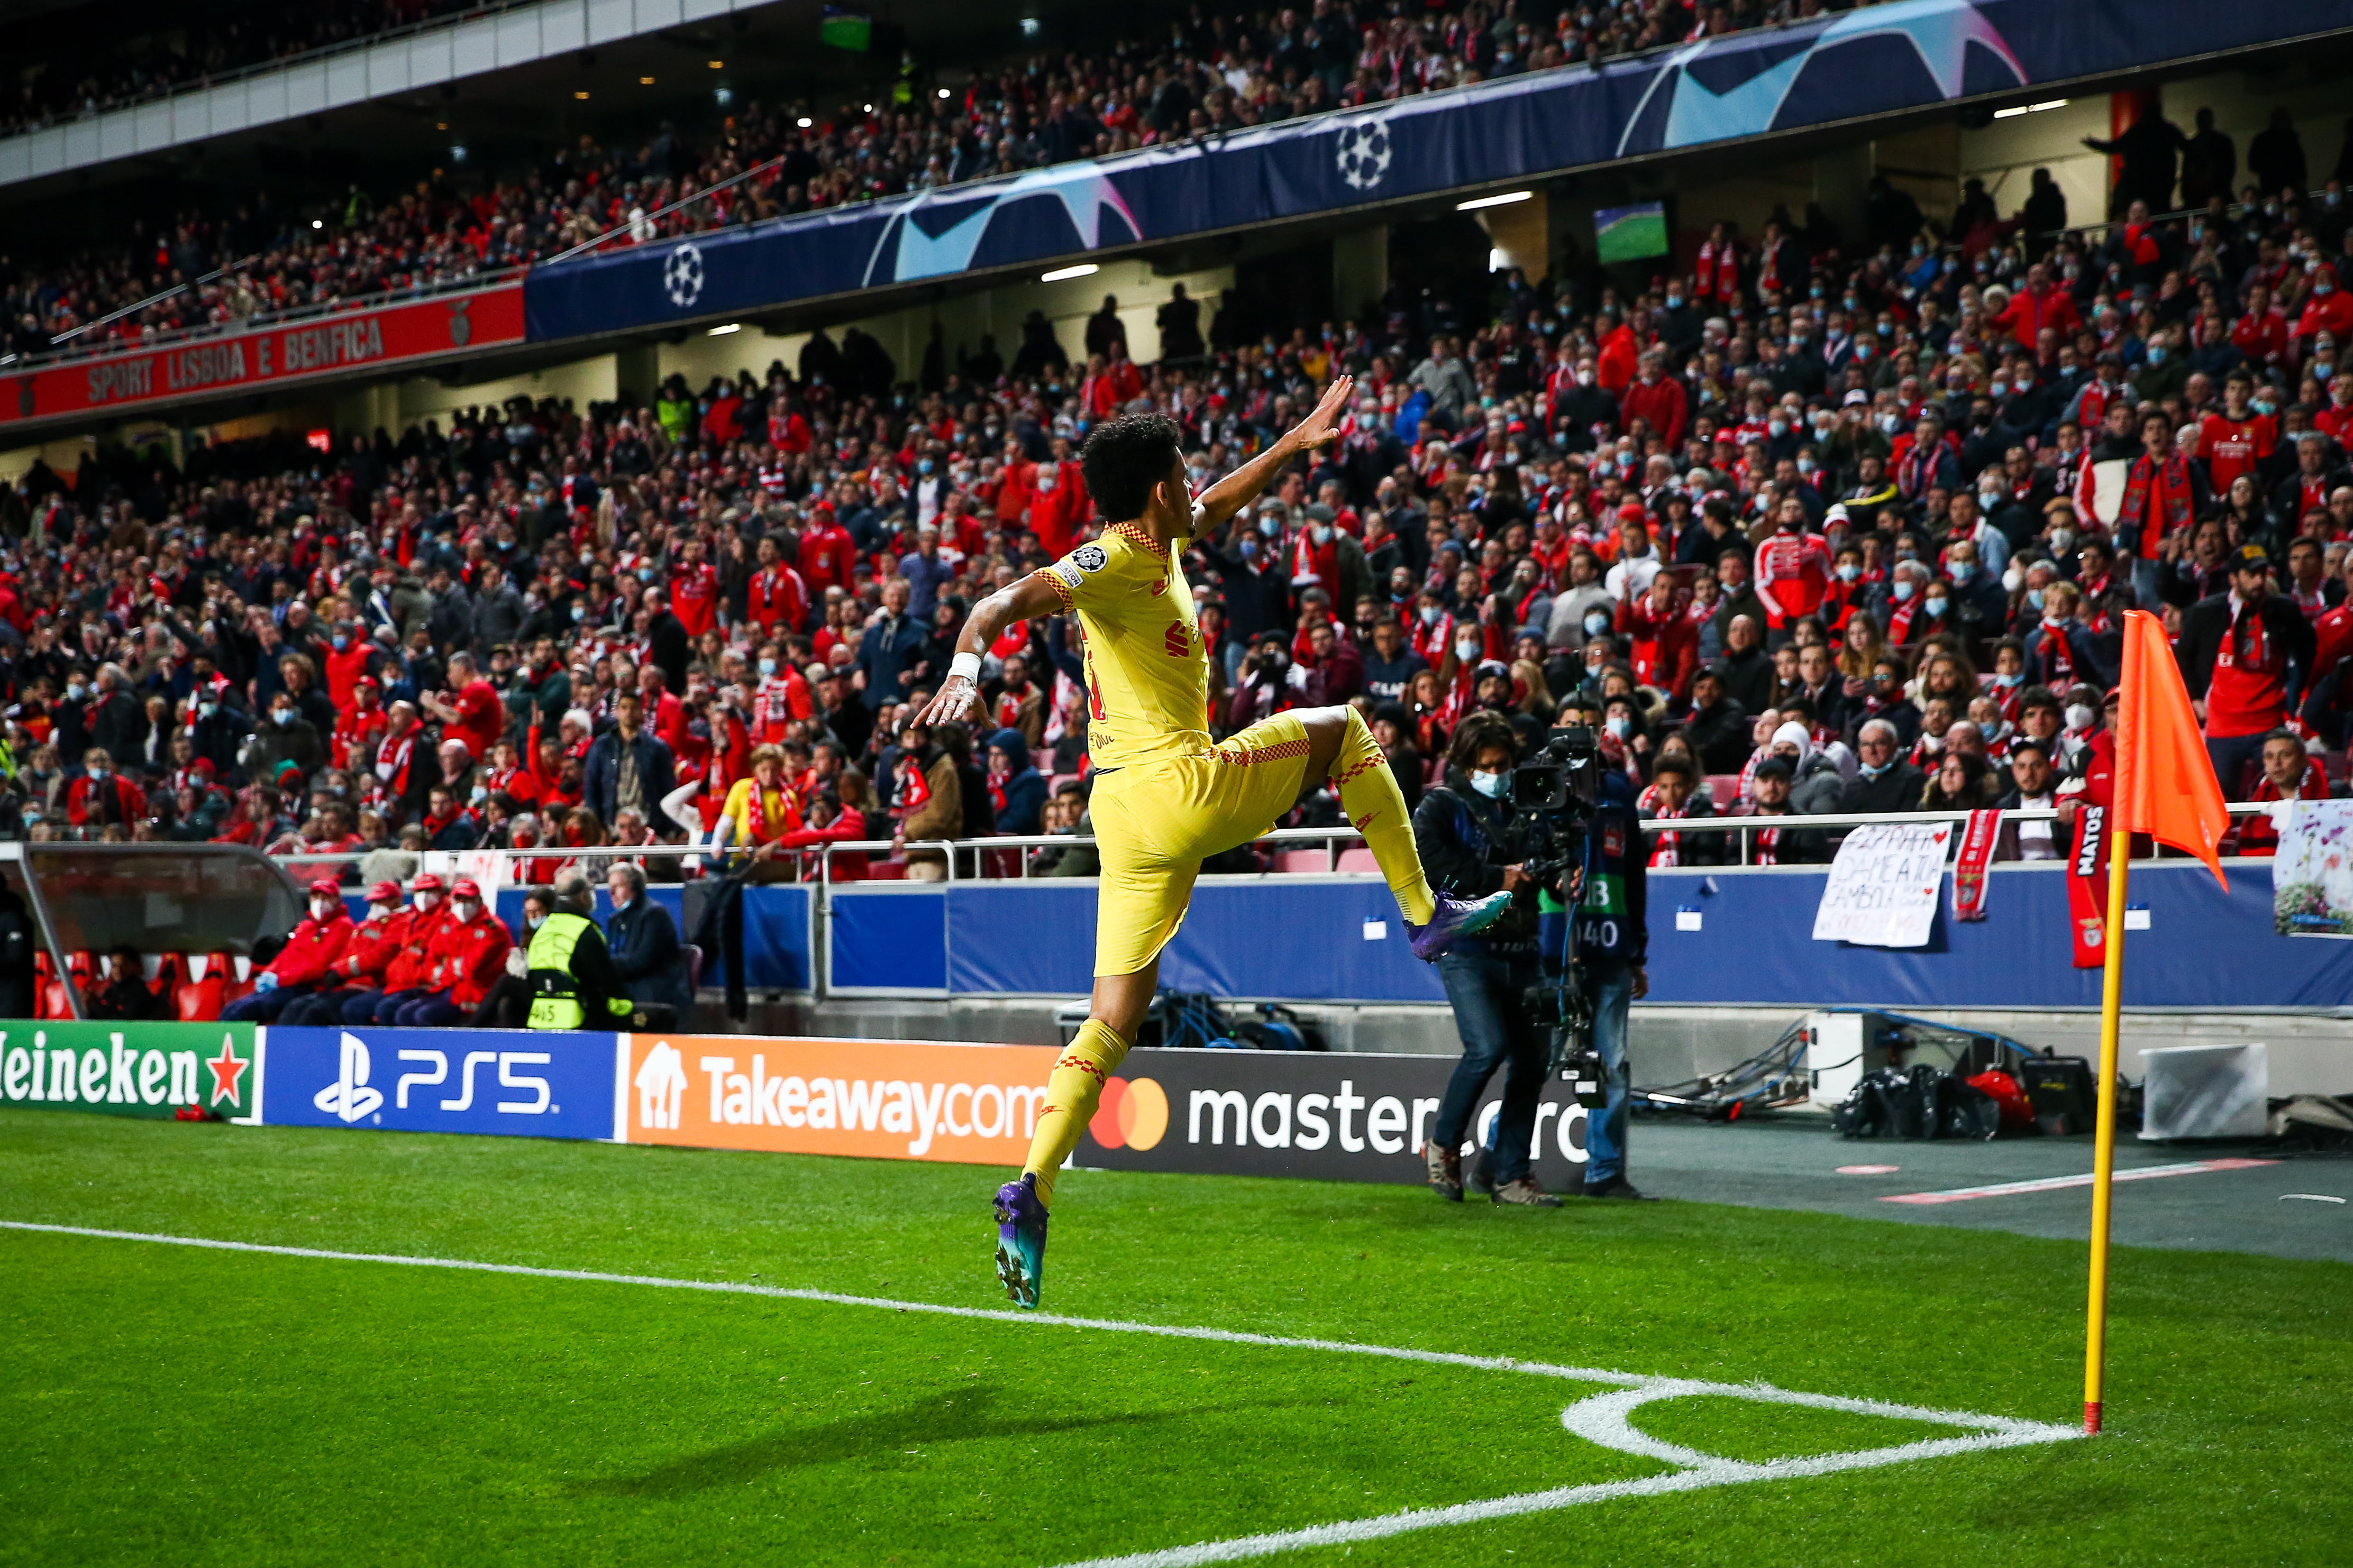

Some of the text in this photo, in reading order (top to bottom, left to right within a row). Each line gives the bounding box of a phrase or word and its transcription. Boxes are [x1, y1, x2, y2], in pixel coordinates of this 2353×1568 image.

[88, 318, 384, 402] SPORT LISBOA E BENFICA
[2077, 806, 2104, 876] MATOS
[0, 1030, 200, 1105] eineken
[396, 1049, 552, 1114] PS5
[700, 1054, 1046, 1156] Takeaway.com
